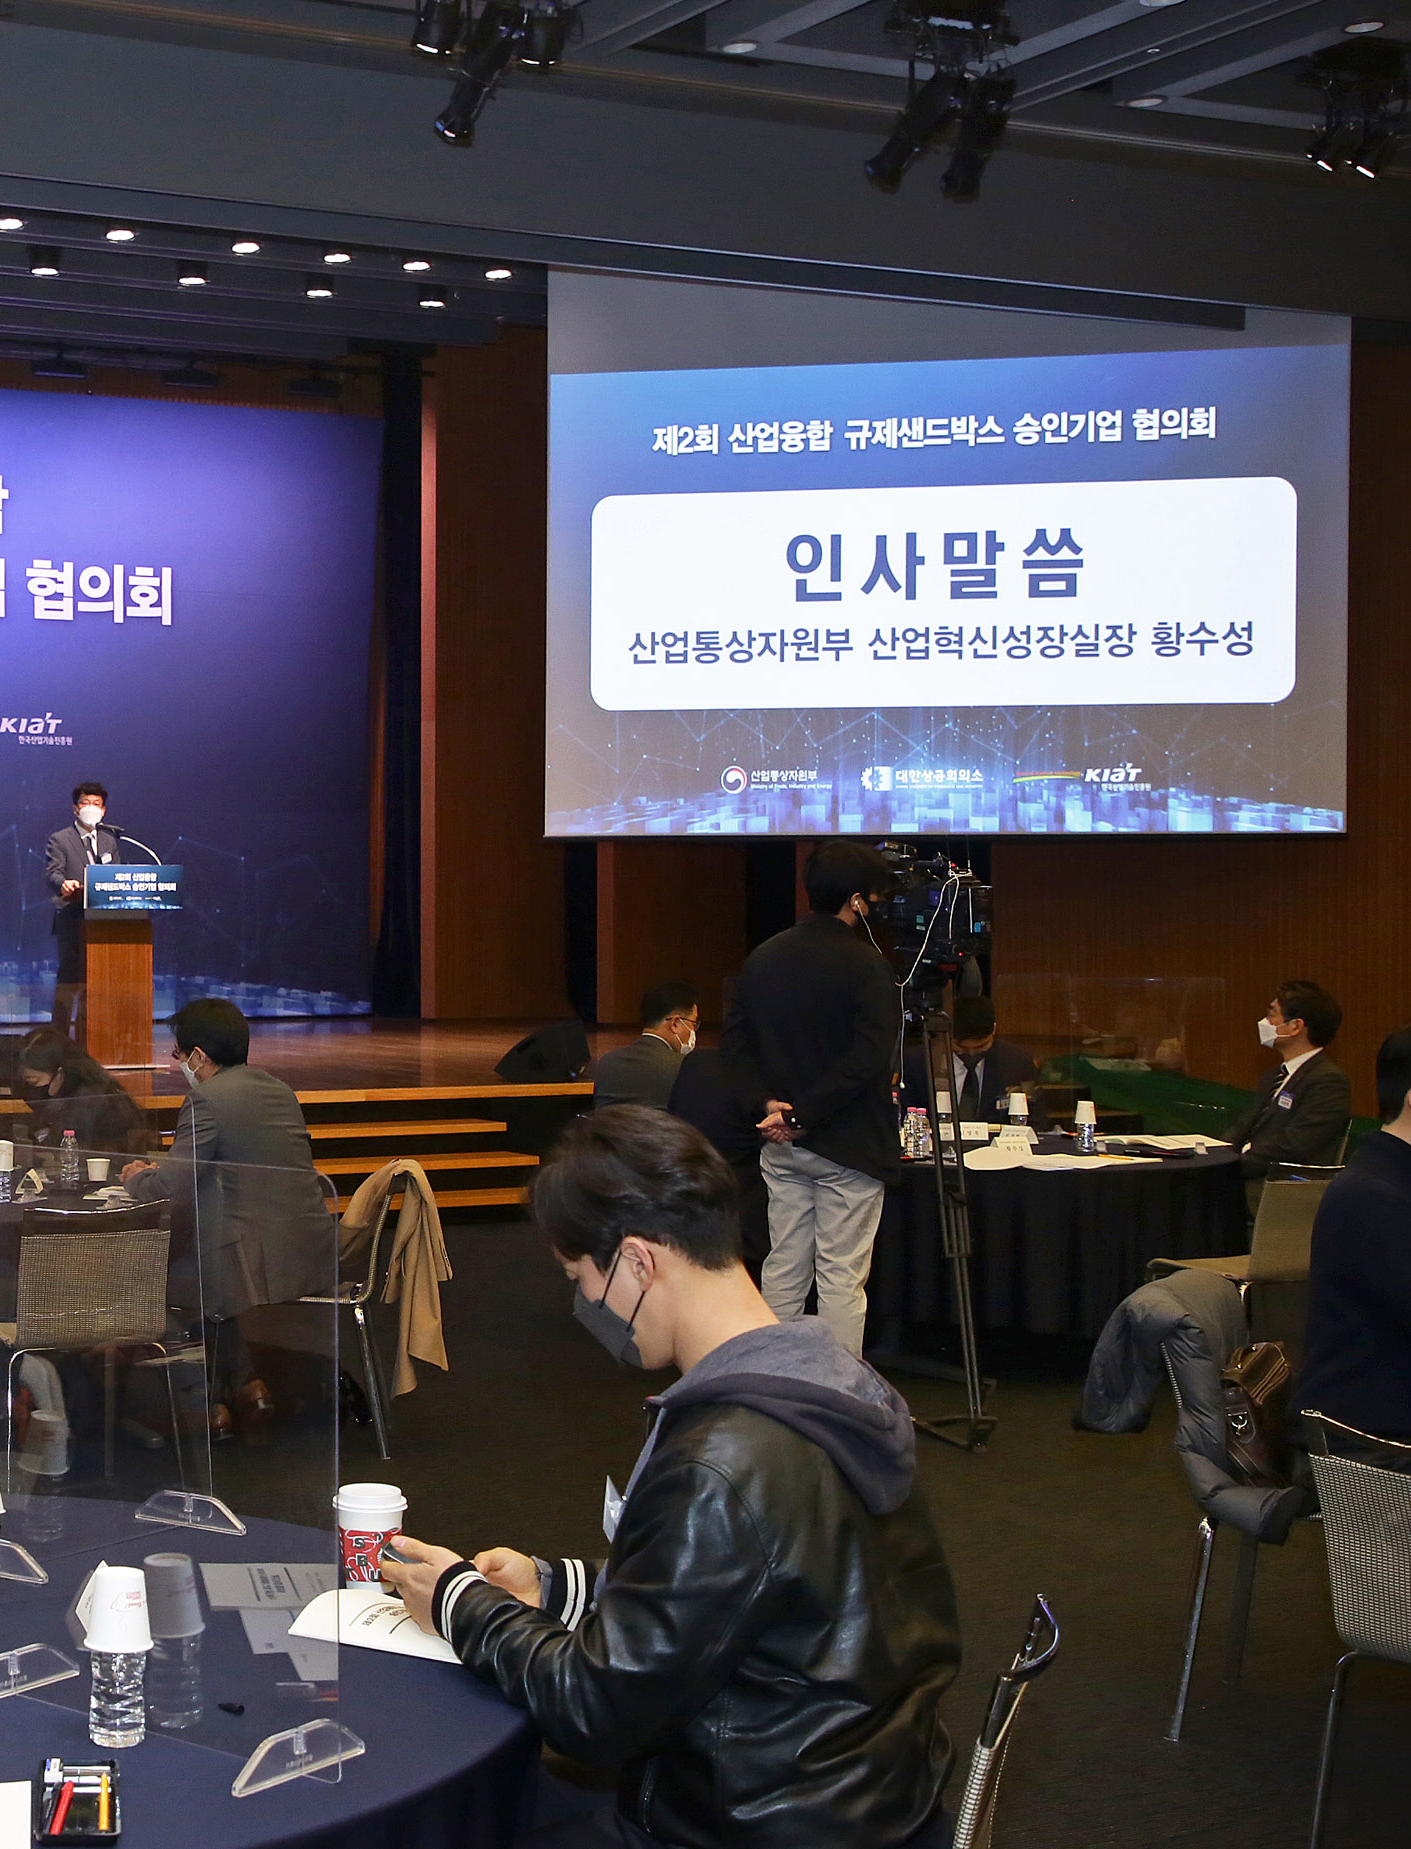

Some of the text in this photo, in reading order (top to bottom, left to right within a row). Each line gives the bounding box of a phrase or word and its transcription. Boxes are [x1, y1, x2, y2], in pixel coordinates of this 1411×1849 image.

[652, 406, 1217, 456] 제2회 산업융합 규제샌드박스 승인기업 협의회
[25, 559, 172, 626] 협의회
[628, 620, 1254, 665] 산업통상자원부 산업혁신성장실장 황수성
[751, 769, 818, 782] 산업통상자원부
[895, 769, 984, 784] 대한상공회의소
